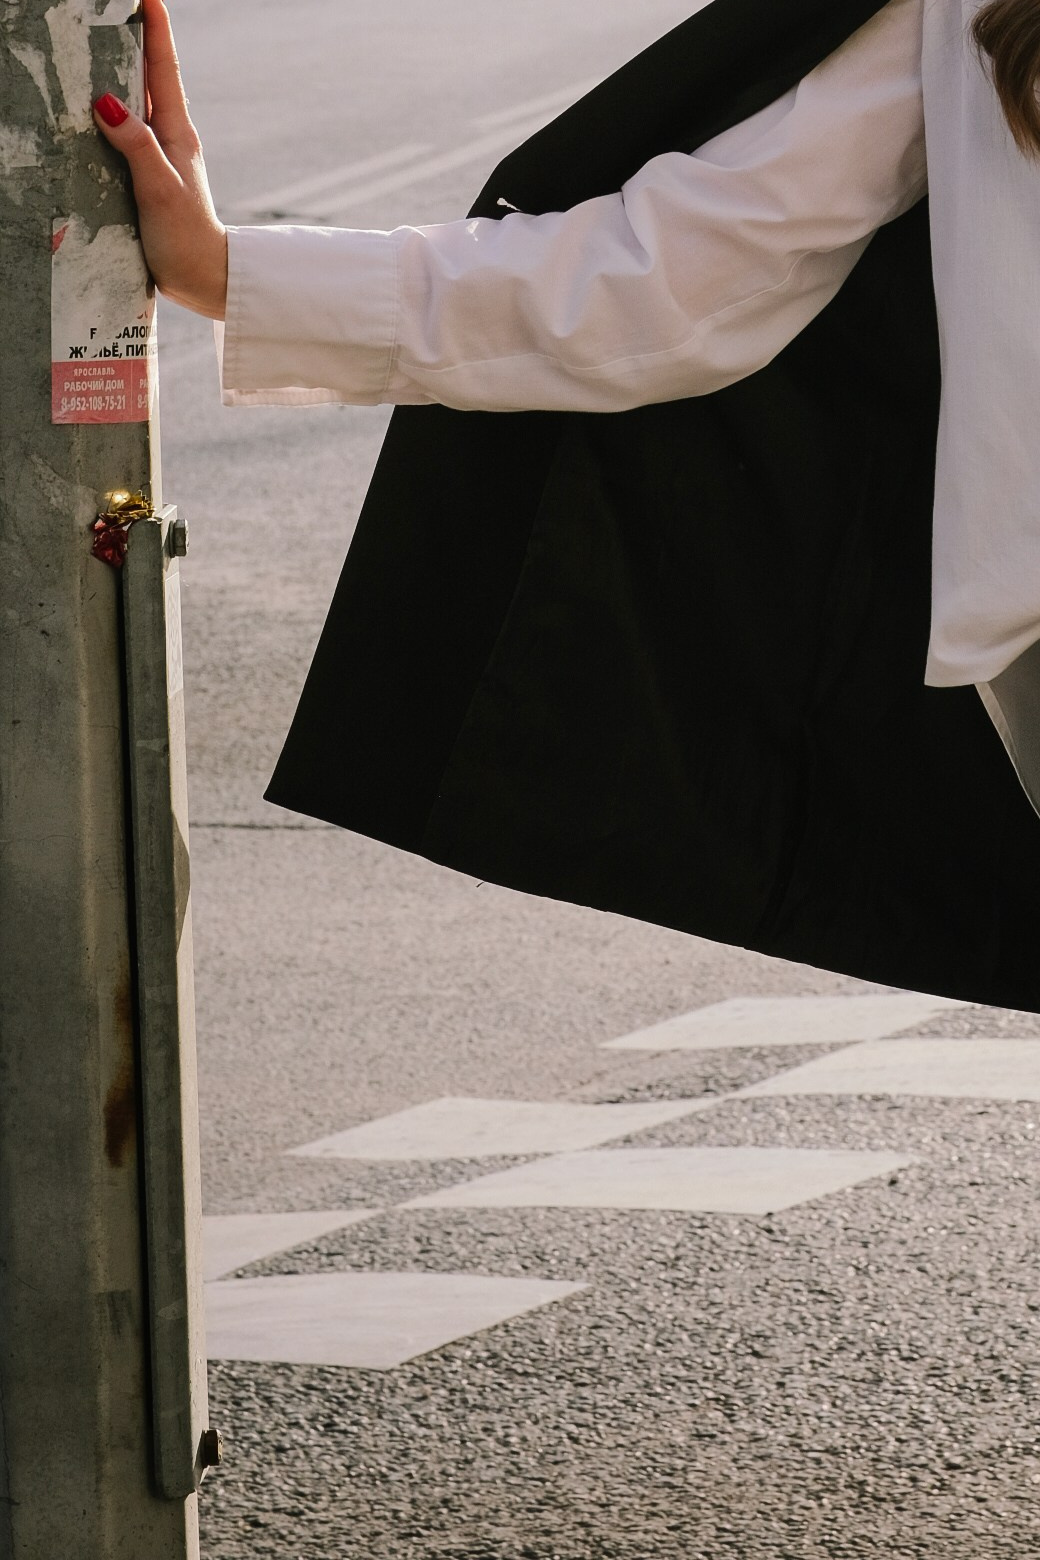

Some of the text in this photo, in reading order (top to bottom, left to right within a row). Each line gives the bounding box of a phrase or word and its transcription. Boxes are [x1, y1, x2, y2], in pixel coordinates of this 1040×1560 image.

[73, 367, 115, 376] ЯРОСЛАВЛЬ
[64, 379, 124, 391] РАБОЧИЙ ДОМ
